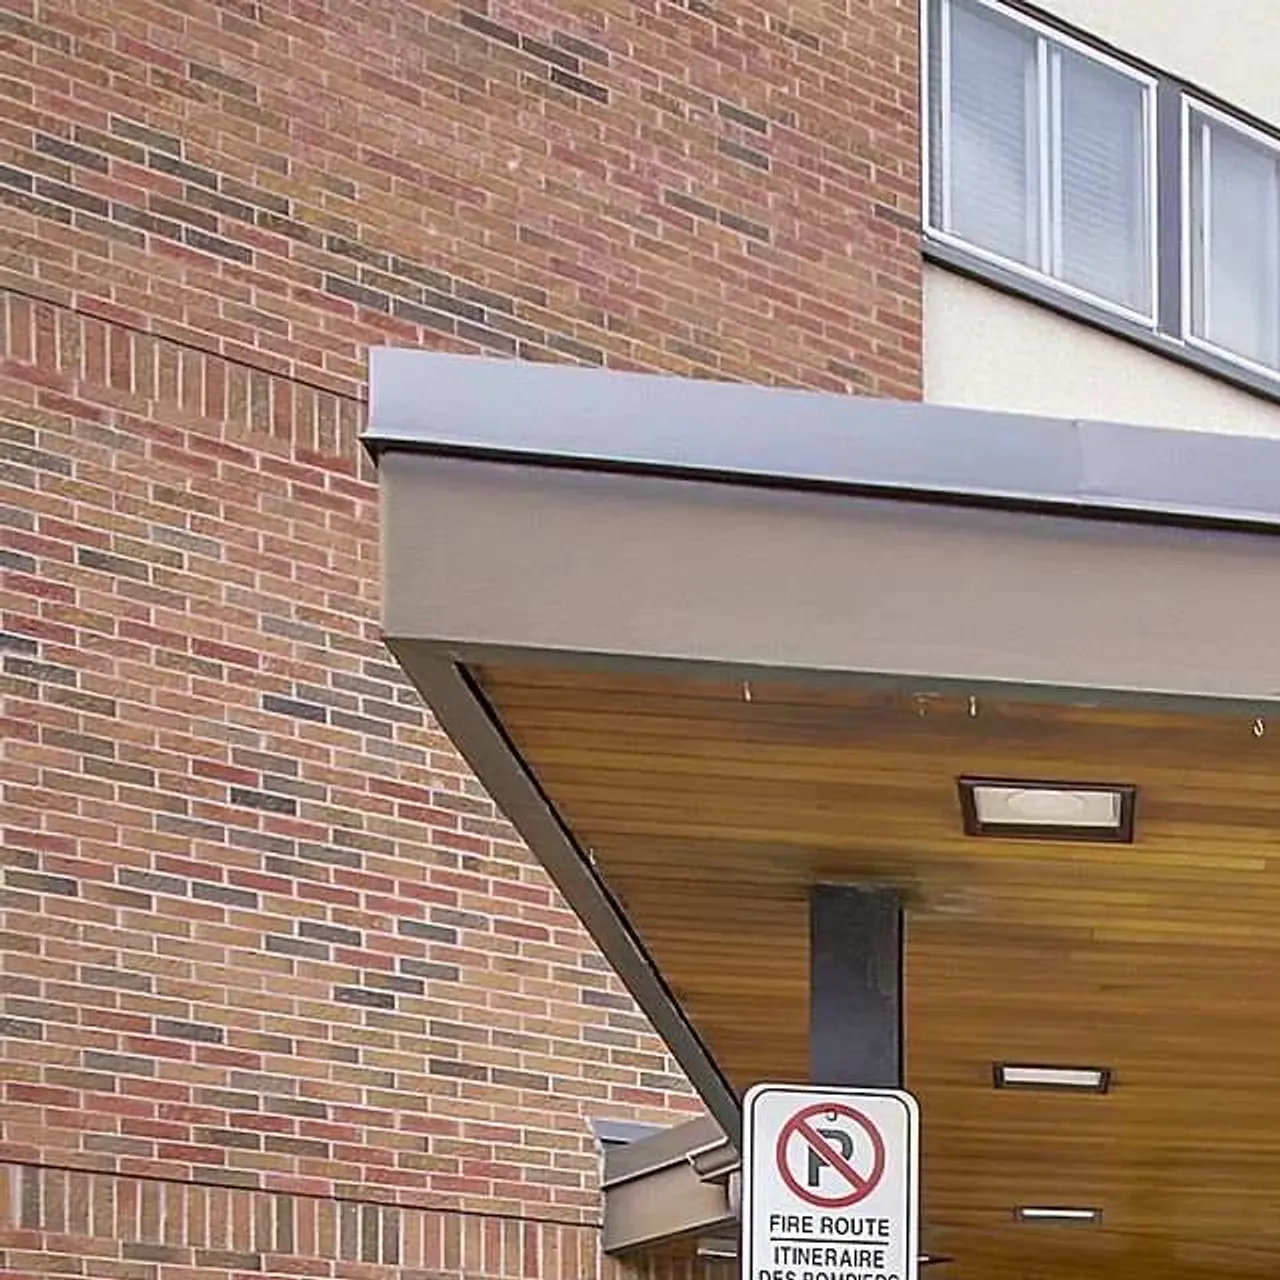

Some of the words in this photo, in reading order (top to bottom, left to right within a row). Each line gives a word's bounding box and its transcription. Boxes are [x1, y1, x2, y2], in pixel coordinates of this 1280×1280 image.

[769, 1214, 813, 1234] FIRE
[820, 1216, 889, 1237] ROUTE
[774, 1246, 885, 1268] ITINERAIRE
